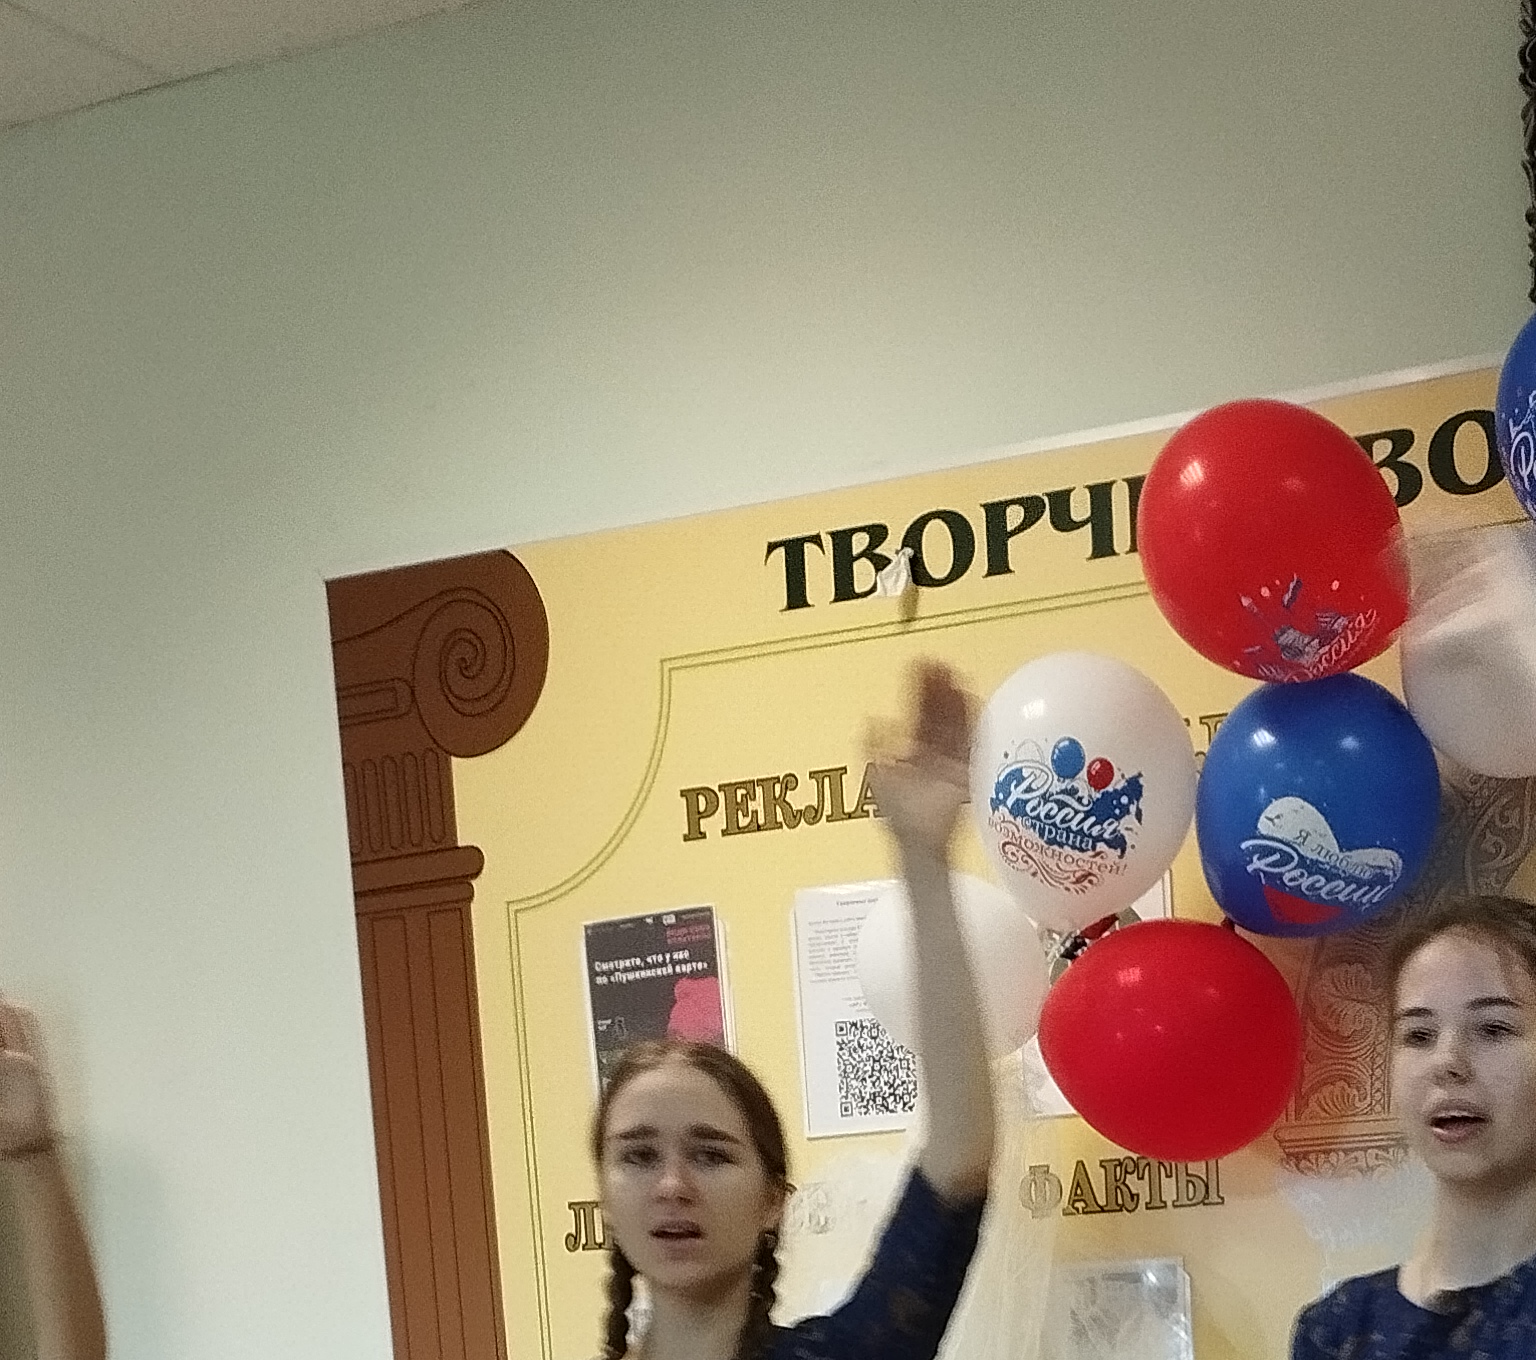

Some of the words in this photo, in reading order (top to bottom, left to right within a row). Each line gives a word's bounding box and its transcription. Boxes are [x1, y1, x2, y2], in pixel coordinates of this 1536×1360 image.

[997, 759, 1120, 839] Россия
[1021, 815, 1092, 850] страна
[1296, 829, 1311, 847] Я
[1018, 1156, 1225, 1219] ФАКТЫ
